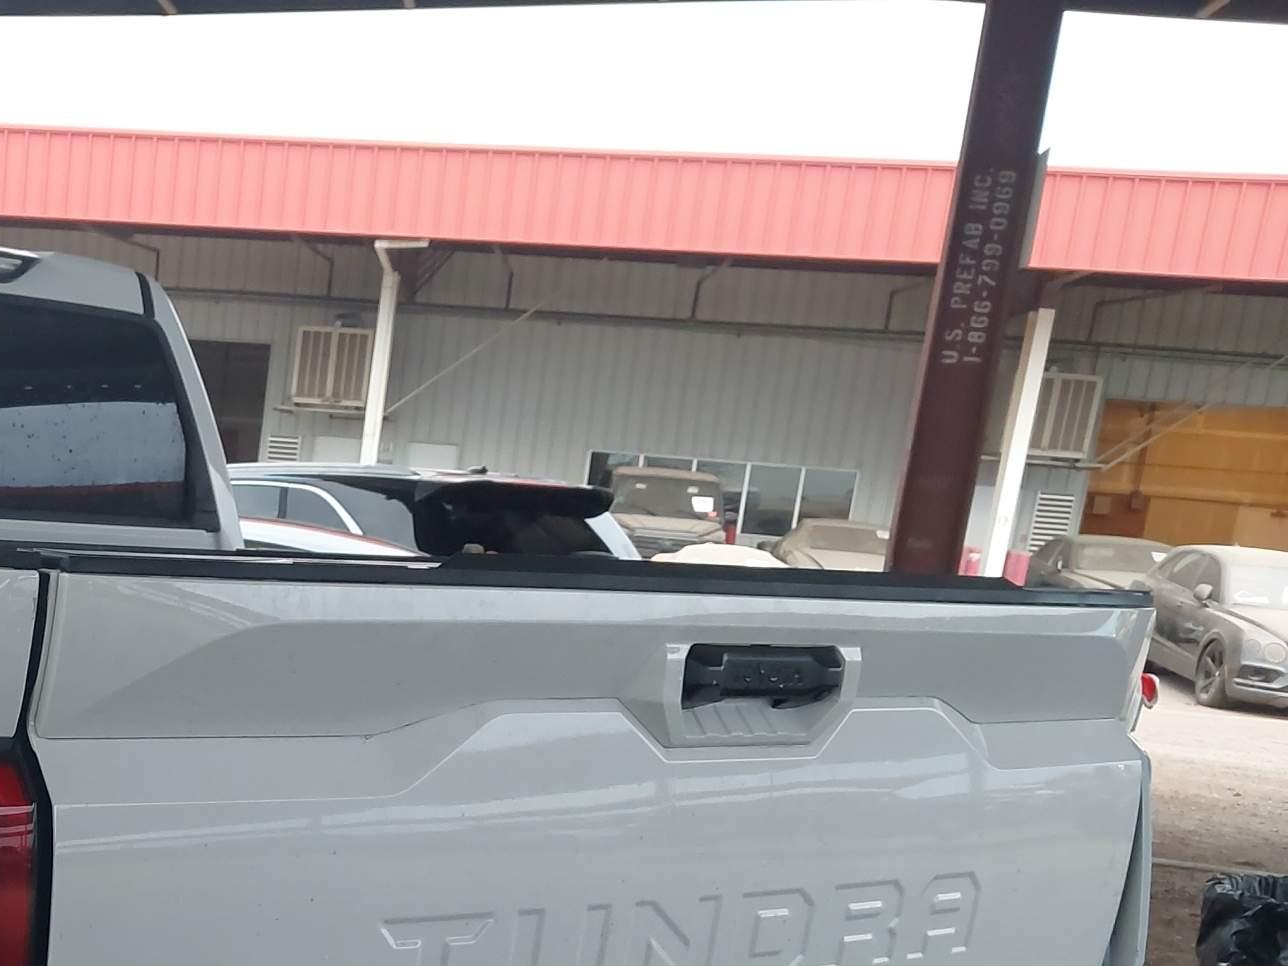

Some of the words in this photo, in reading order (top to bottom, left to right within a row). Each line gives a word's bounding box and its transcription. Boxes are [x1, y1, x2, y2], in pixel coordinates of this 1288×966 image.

[968, 168, 993, 210] INC.
[951, 222, 983, 309] PREFAB
[941, 321, 966, 364] U.S.
